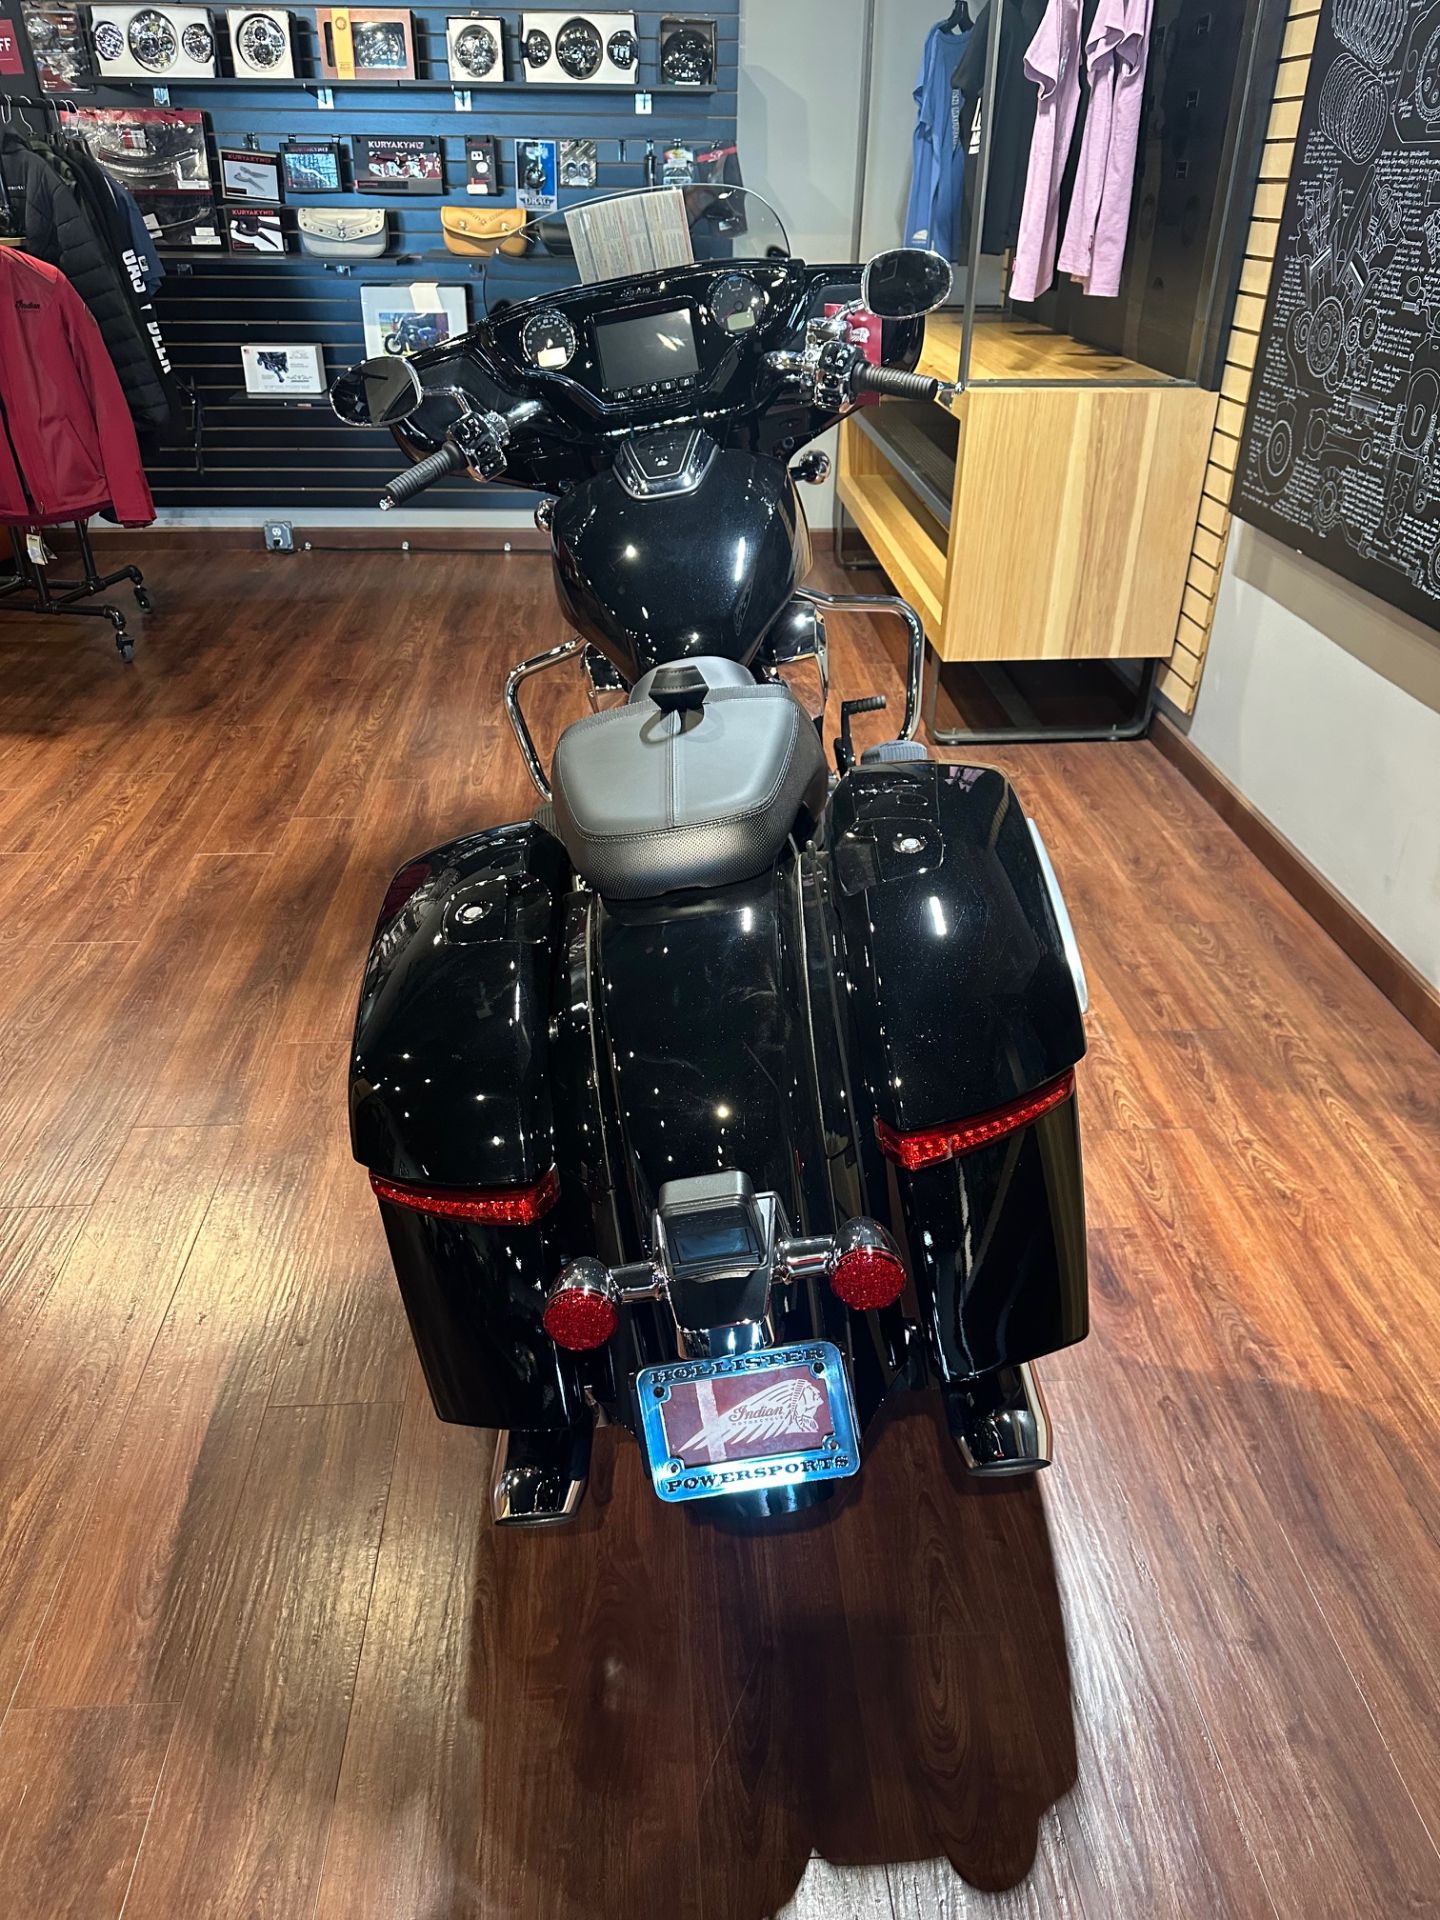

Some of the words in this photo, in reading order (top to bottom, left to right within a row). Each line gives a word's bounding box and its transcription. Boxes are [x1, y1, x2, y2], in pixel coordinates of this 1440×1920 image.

[651, 1349, 826, 1384] HOLLISTER
[728, 1404, 783, 1422] Indian
[667, 1456, 849, 1492] POWERSPORTS
